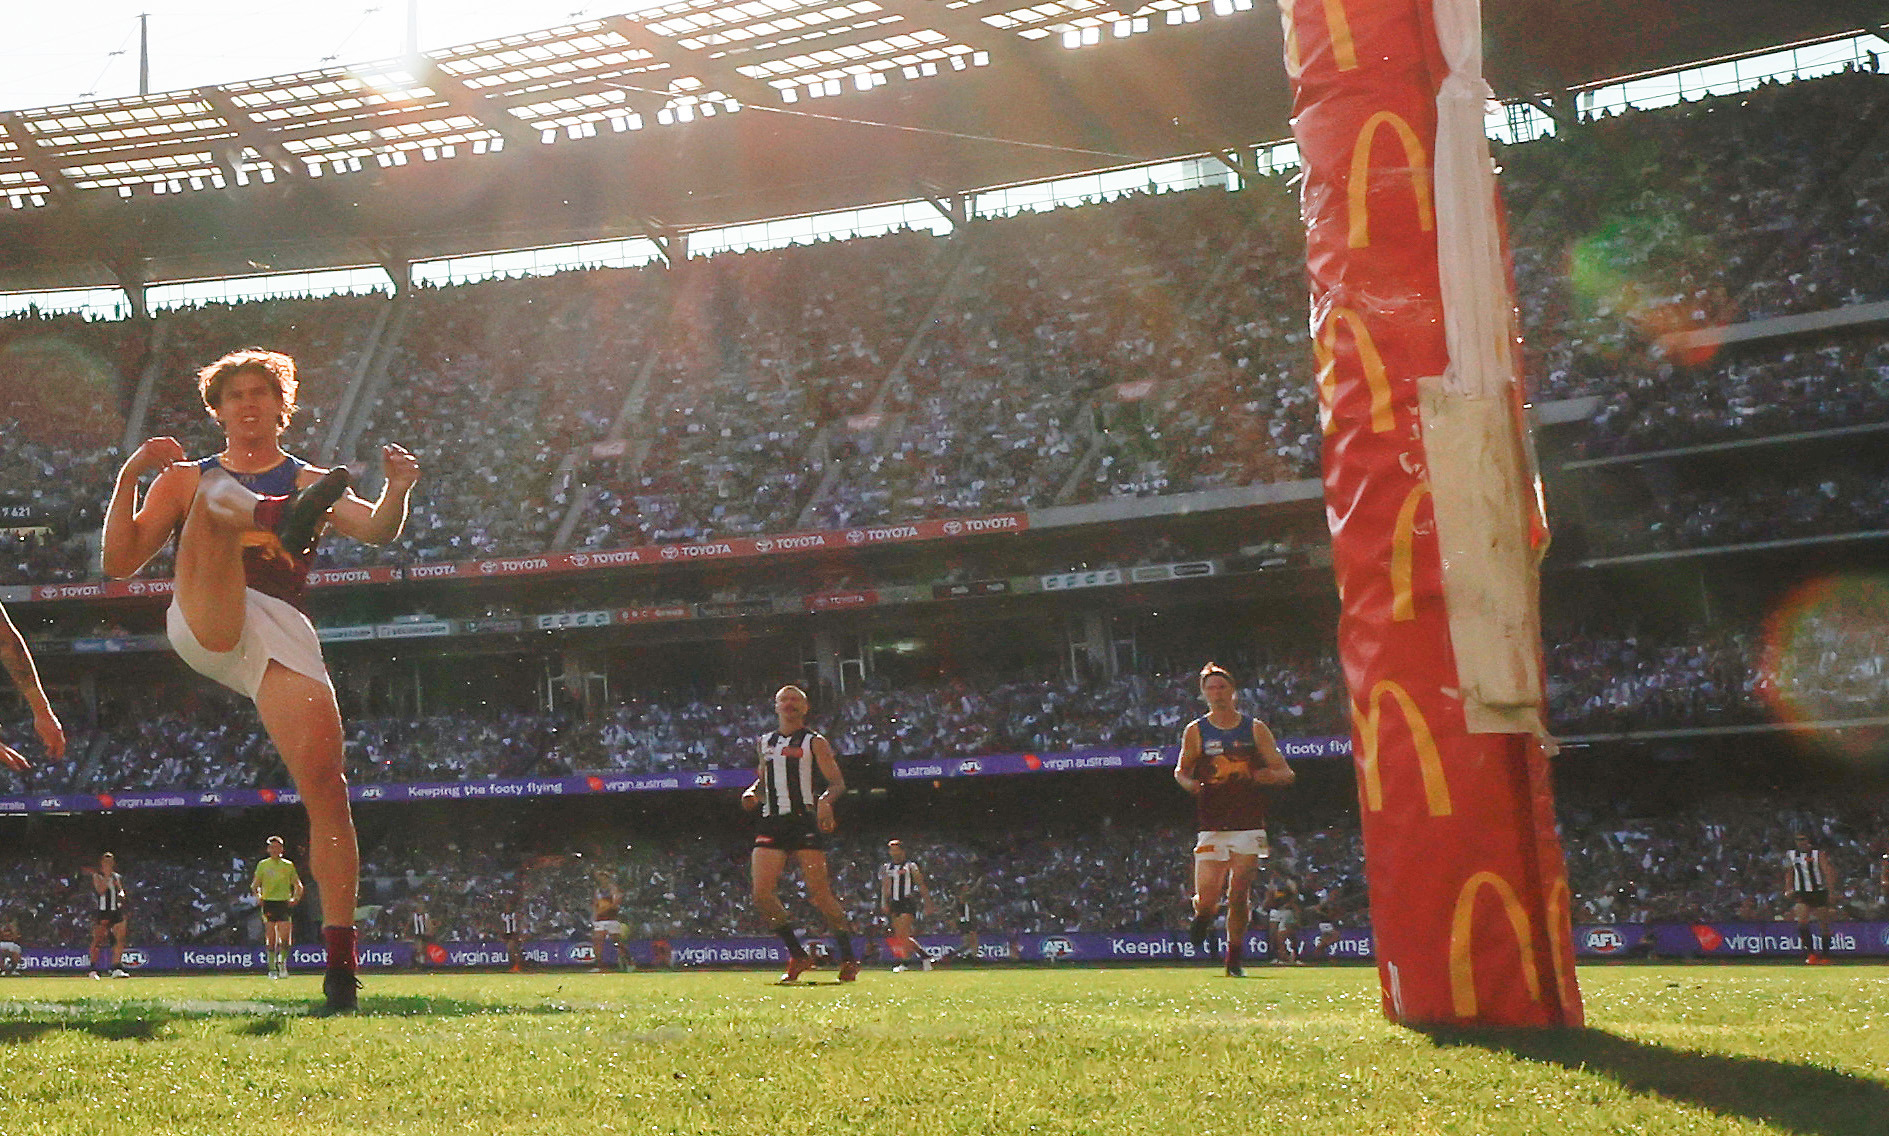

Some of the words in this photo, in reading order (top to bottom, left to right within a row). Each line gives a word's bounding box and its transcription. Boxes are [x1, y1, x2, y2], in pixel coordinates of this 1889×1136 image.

[325, 570, 370, 582] TOYOTA
[411, 565, 456, 577] TOYOTA
[502, 560, 548, 572] TOYOTA
[592, 552, 640, 564] TOYOTA
[682, 544, 732, 556] TOYOTA
[776, 536, 825, 550] TOYOTA
[868, 526, 918, 541] TOYOTA
[966, 517, 1017, 532] TOYOTA
[1141, 752, 1163, 760] AFL
[1285, 743, 1324, 756] footy
[960, 761, 982, 770] AFL
[408, 786, 460, 798] Keeping
[464, 785, 485, 795] the
[490, 783, 524, 795] footy
[526, 782, 562, 794] flying
[1044, 941, 1074, 953] AFL
[1587, 934, 1622, 947] AFL
[1724, 933, 1776, 953] virgin
[184, 951, 252, 966] Keeping
[450, 952, 488, 966] virgin
